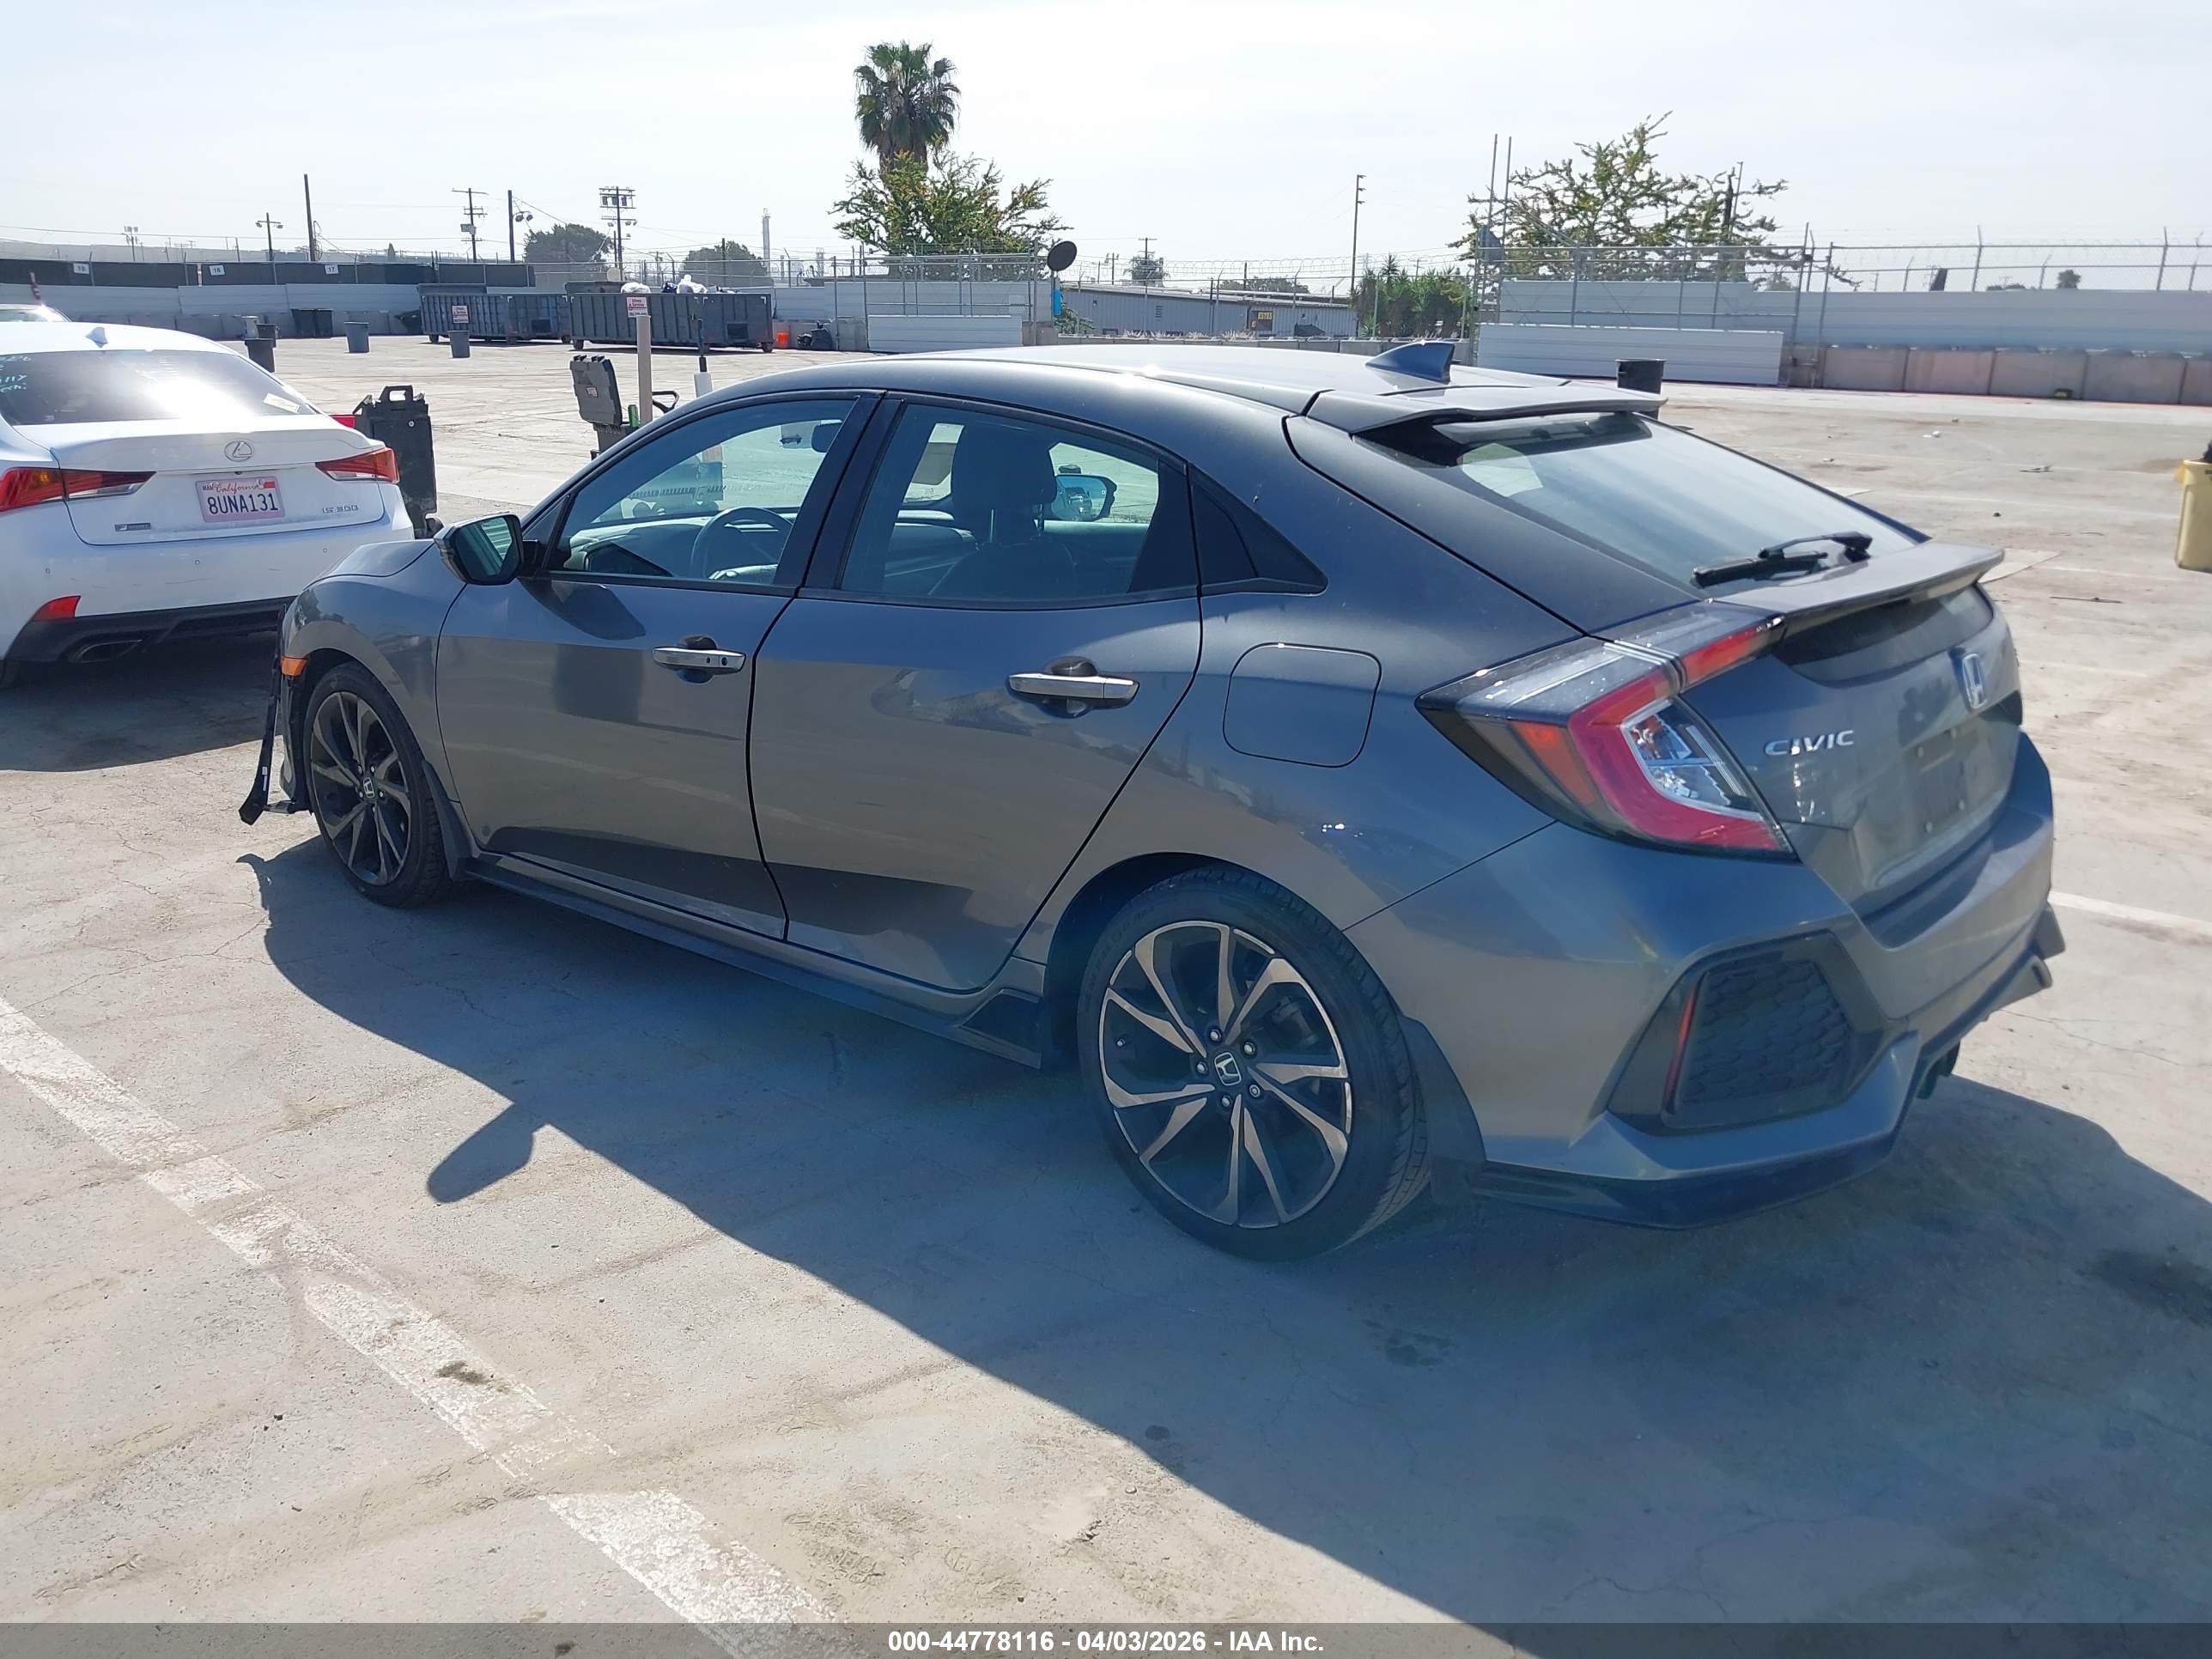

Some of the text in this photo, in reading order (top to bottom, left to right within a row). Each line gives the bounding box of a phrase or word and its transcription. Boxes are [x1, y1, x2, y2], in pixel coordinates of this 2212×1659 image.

[216, 482, 263, 494] California
[207, 493, 278, 514] 8UNA131
[1765, 730, 1854, 756] CIVIC
